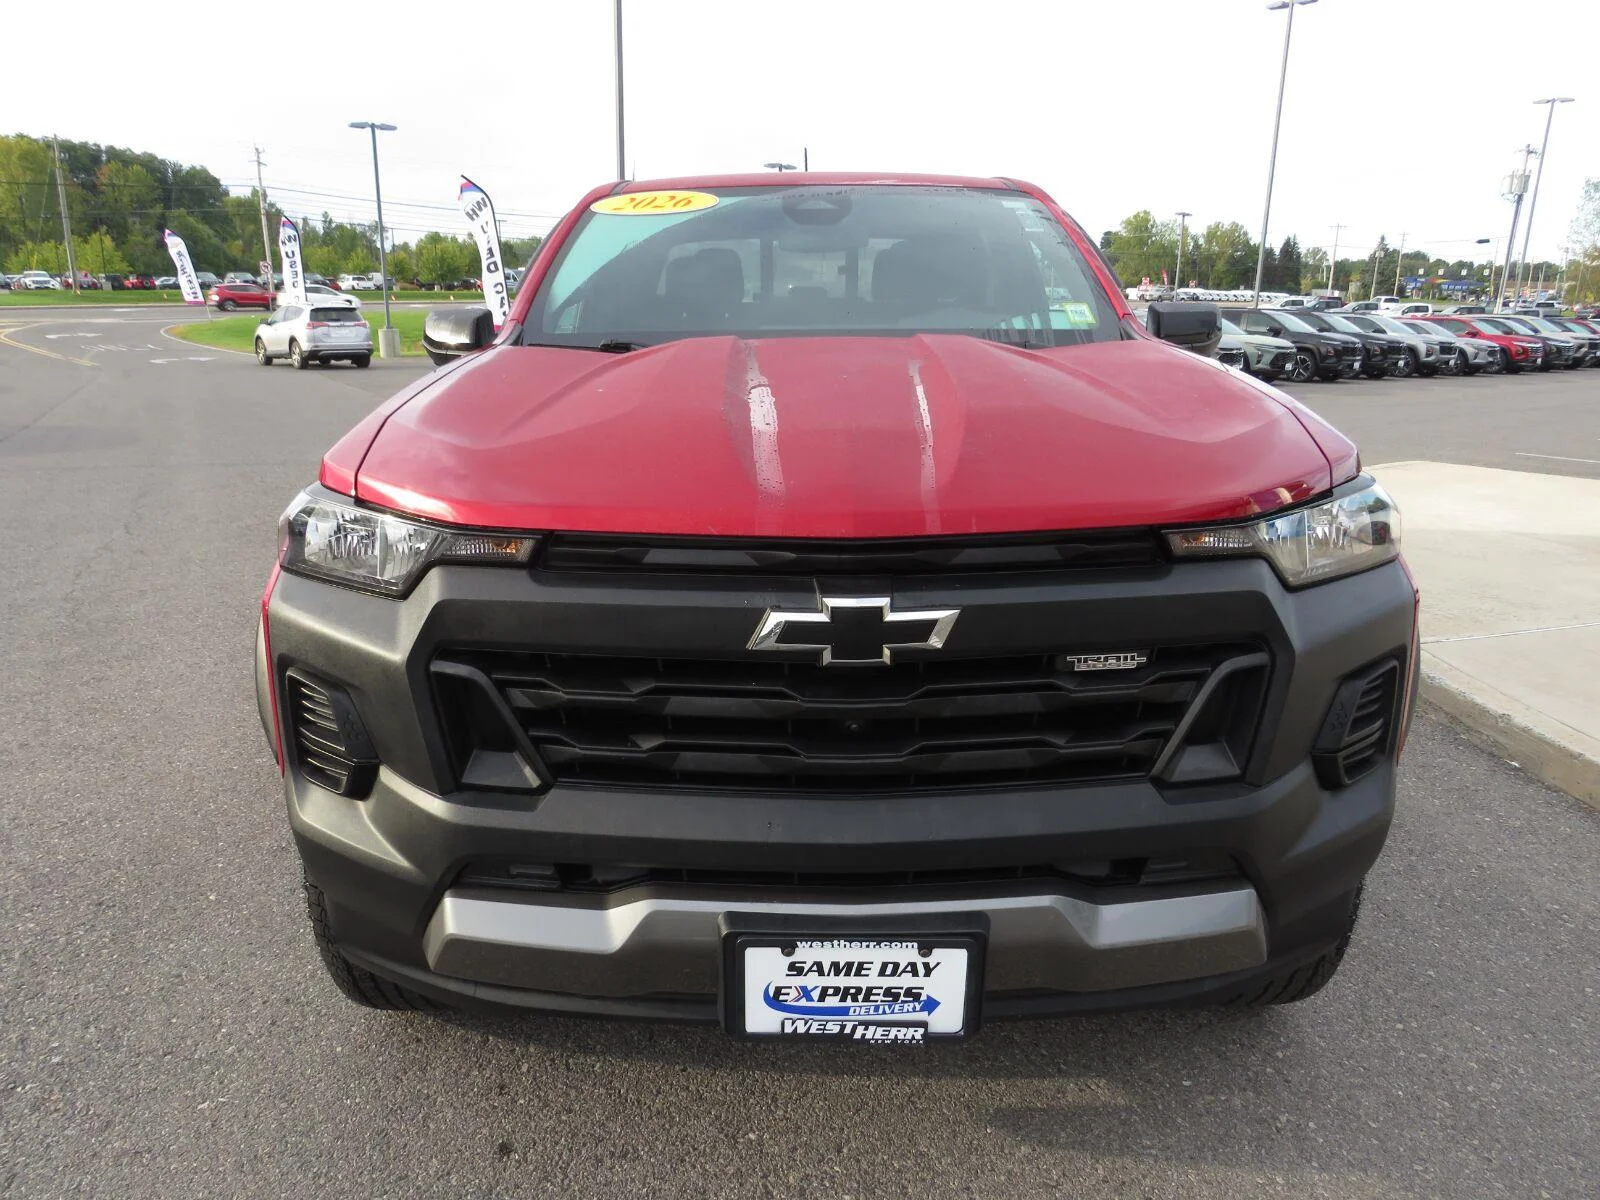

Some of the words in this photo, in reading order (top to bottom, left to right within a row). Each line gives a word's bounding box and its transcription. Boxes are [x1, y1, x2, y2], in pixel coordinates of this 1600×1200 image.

[612, 195, 696, 211] 2026
[1066, 652, 1147, 664] TRAIL
[796, 939, 918, 949] westherr.com
[785, 961, 874, 977] SAME
[877, 961, 942, 977] DAY
[772, 985, 925, 1003] EXPRESS
[848, 1001, 925, 1016] DELIVERY
